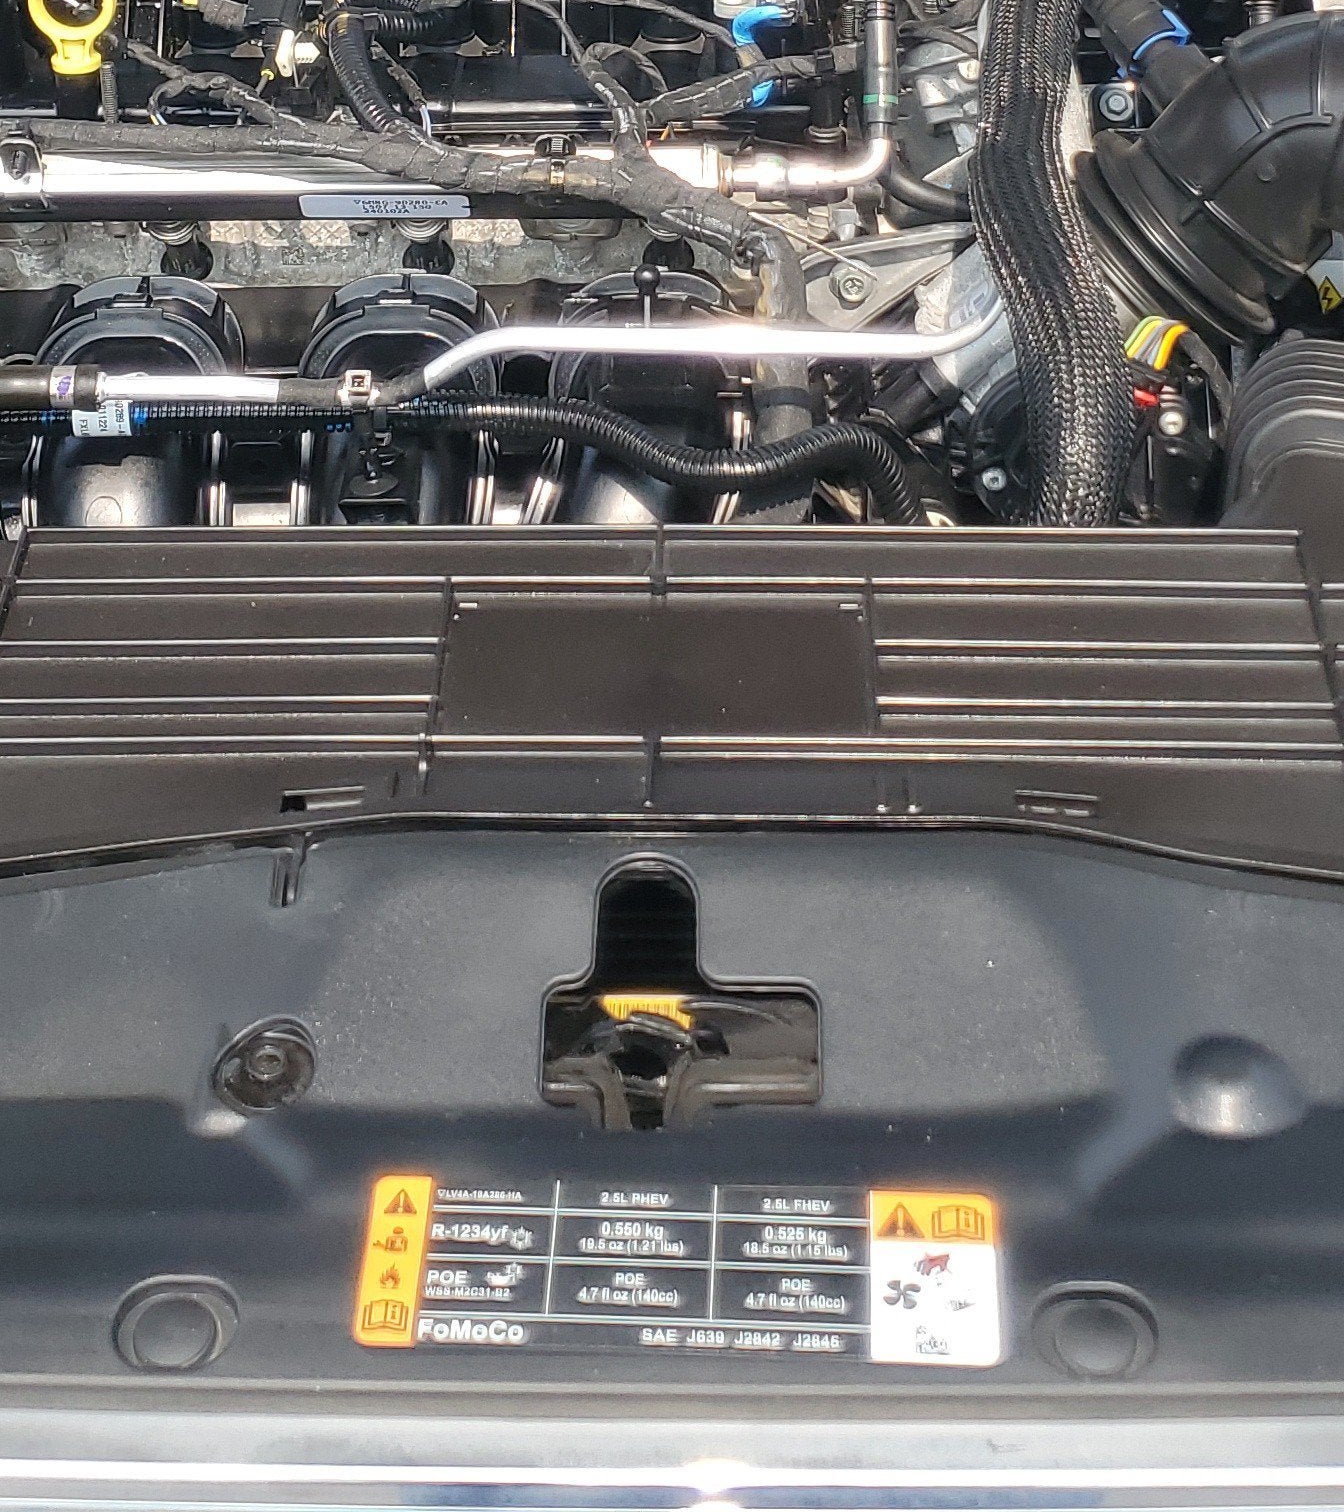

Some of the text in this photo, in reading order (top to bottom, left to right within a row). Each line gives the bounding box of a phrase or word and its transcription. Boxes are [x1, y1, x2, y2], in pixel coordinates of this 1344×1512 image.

[601, 1191, 669, 1205] 2.5L PHEV
[763, 1197, 831, 1211] 2.5L FHEV
[431, 1223, 509, 1242] R-1234yf
[601, 1221, 665, 1240] 0.550 kg
[764, 1226, 828, 1245] 0.525 kg
[610, 1240, 624, 1251] oz
[773, 1244, 788, 1254] oz
[427, 1269, 468, 1285] POE
[615, 1272, 645, 1285] POE
[781, 1278, 811, 1291] POE
[578, 1287, 678, 1307] 4.7 fl oz (140cc)
[745, 1292, 766, 1305] 4.7
[769, 1293, 777, 1306] fl
[780, 1296, 796, 1307] oz
[418, 1319, 524, 1342] FoMoCo
[642, 1328, 677, 1343] SAE
[734, 1331, 781, 1346] J2842
